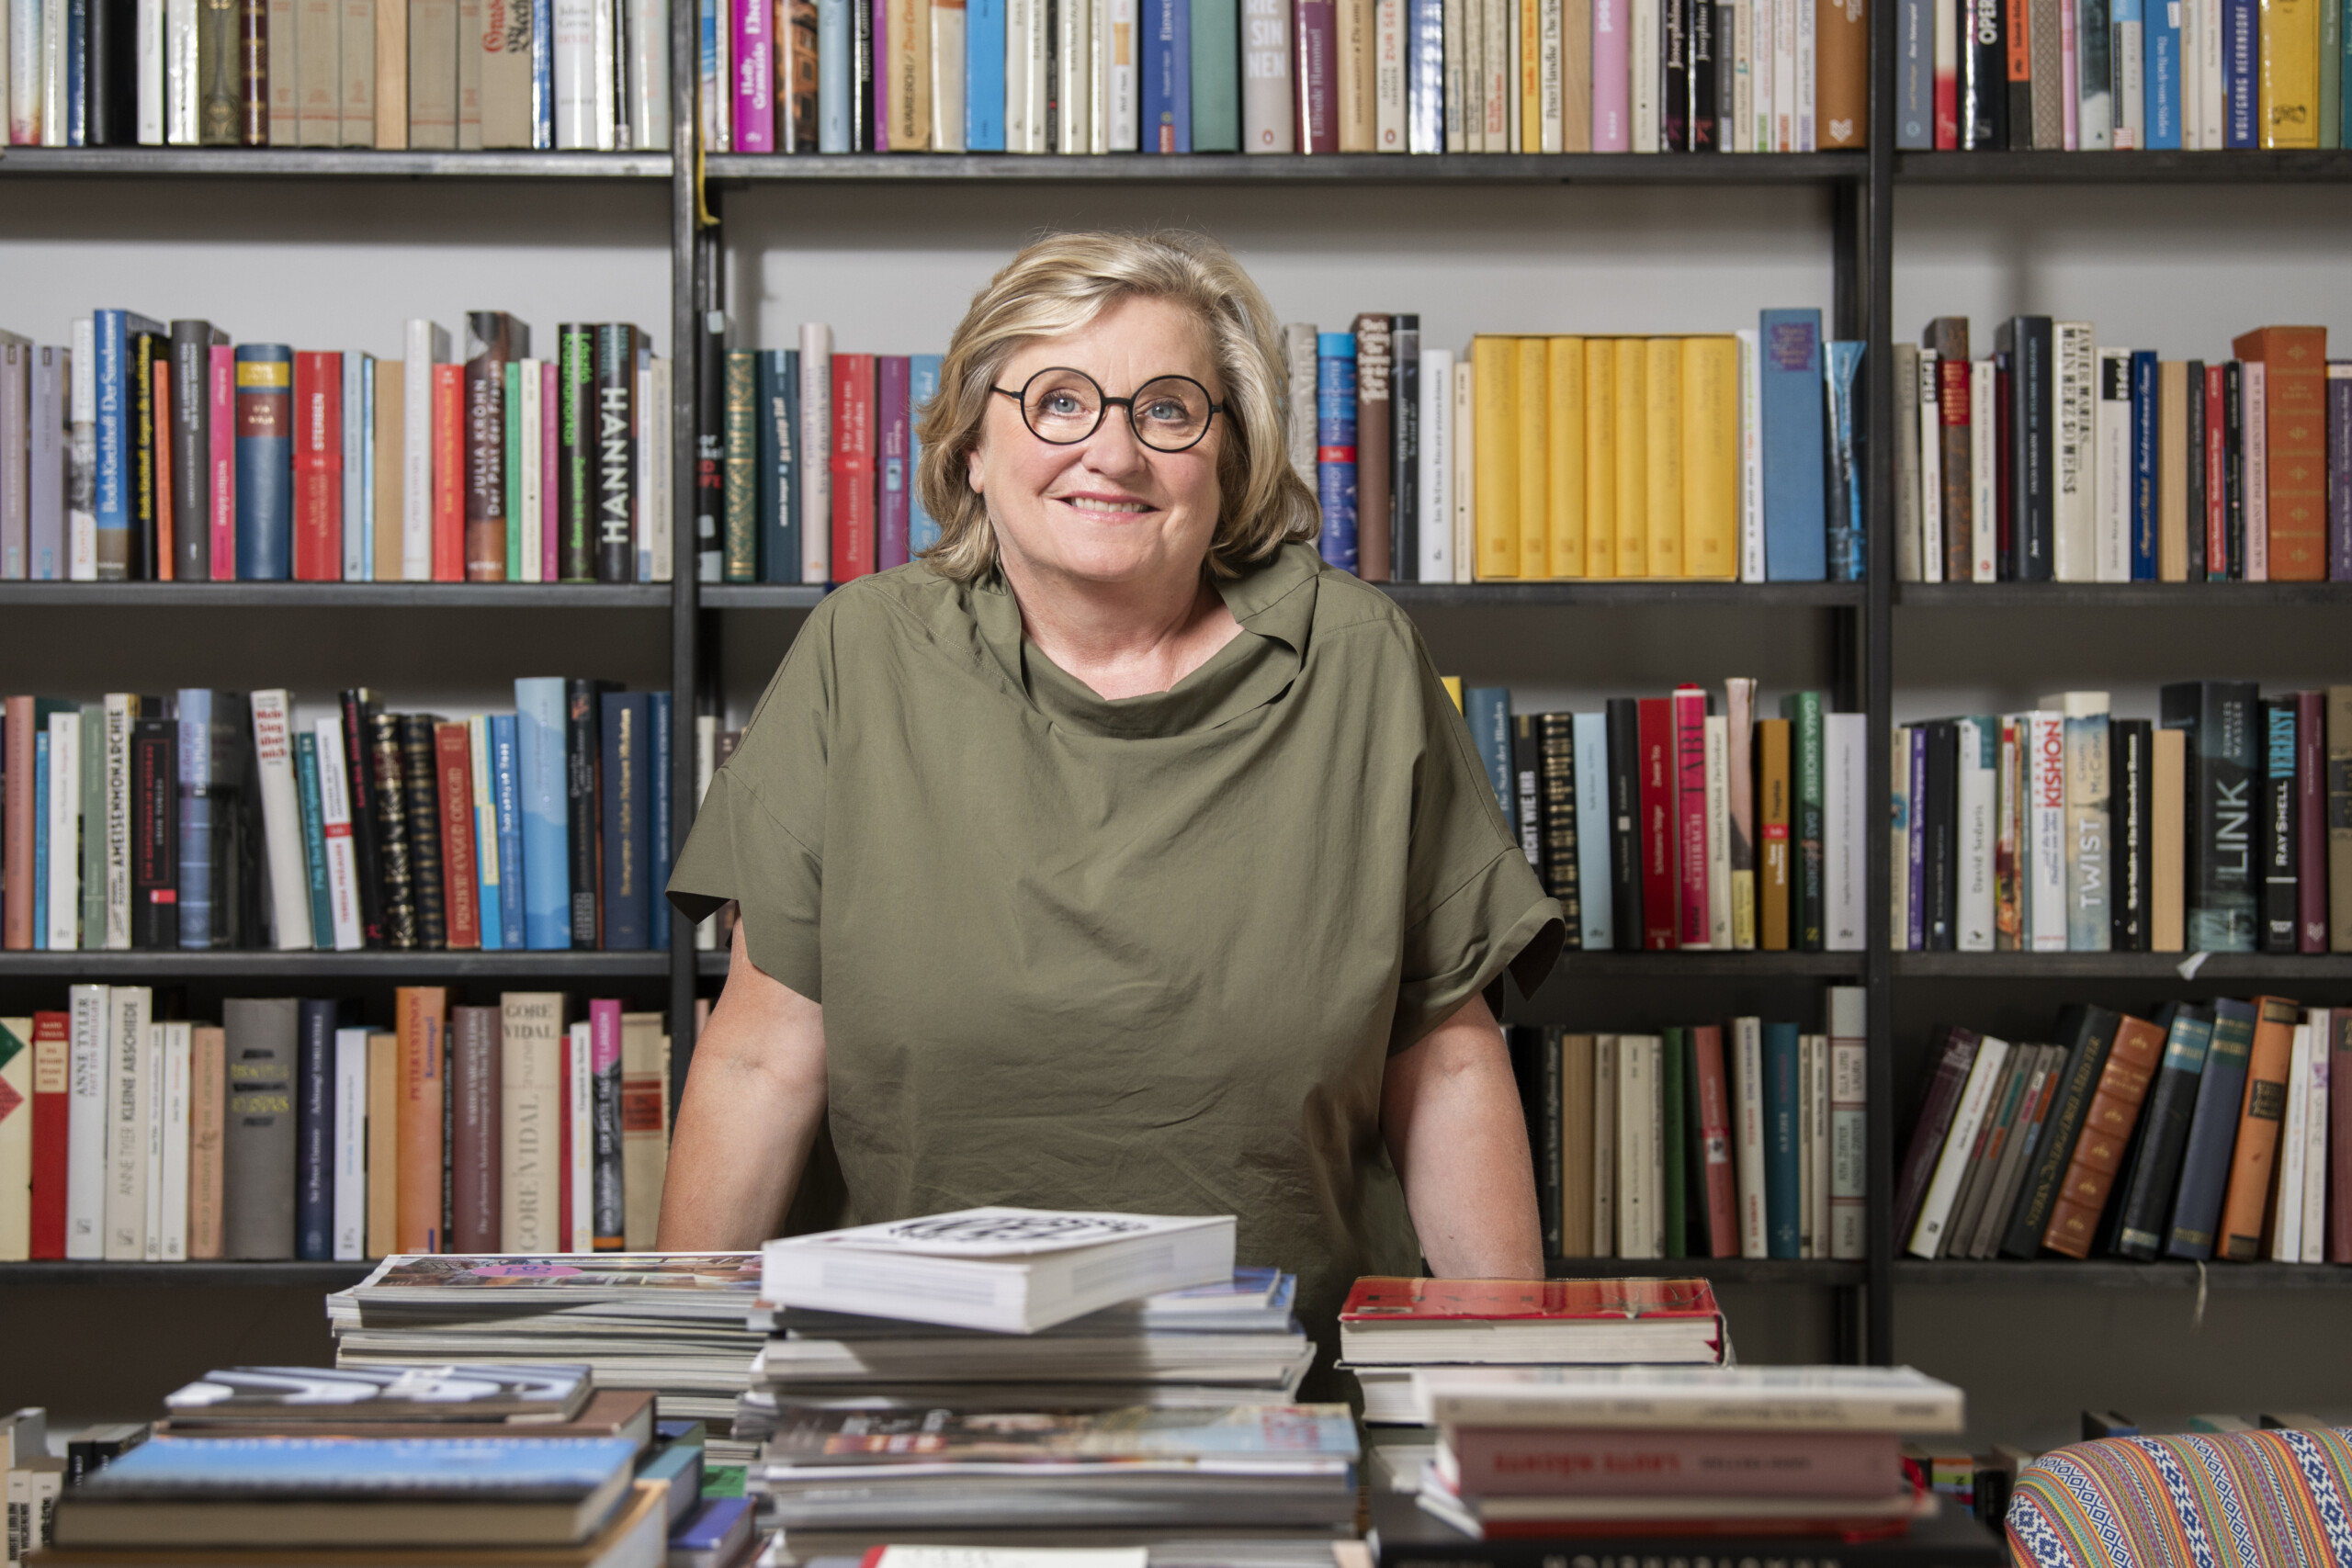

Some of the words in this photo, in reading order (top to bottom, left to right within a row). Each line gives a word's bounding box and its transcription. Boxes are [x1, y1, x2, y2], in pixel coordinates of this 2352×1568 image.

[1251, 20, 1284, 47] SIN
[1248, 52, 1286, 79] NEN
[2234, 77, 2249, 140] WOLFGANG
[2061, 328, 2077, 369] MEIN
[487, 360, 502, 412] Frauen
[2061, 372, 2077, 417] HERZ
[2115, 357, 2131, 401] PIPER
[311, 392, 326, 451] STERBEN
[469, 379, 487, 441] KRÖHN
[487, 419, 501, 445] der
[2061, 420, 2076, 442] SO
[472, 446, 487, 497] JULIA
[487, 448, 501, 484] Pakt
[601, 387, 628, 543] HANNAH
[2061, 444, 2077, 494] WEISS
[487, 488, 501, 515] Der
[2233, 701, 2245, 757] WASSER
[1519, 770, 1536, 795] IHR
[2042, 719, 2064, 808] KISHON
[108, 709, 126, 867] AMEISENMONARCHIE
[1520, 797, 1537, 824] WIE
[2273, 779, 2290, 832] SHELL
[1521, 826, 1540, 865] NICHT
[2214, 777, 2250, 874] LINK
[2079, 818, 2103, 910] TWIST
[2274, 832, 2290, 866] RAY
[74, 998, 89, 1047] TYLER
[503, 1022, 555, 1041] VIDAL
[504, 1003, 553, 1020] GORE
[120, 1000, 138, 1073] ABSCHIEDE
[75, 1054, 90, 1098] ANNE
[121, 1077, 137, 1122] KLEINE
[120, 1126, 135, 1157] TYLER
[517, 1094, 541, 1175] VIDAL
[119, 1160, 136, 1197] ANNE
[518, 1181, 540, 1251] GORE
